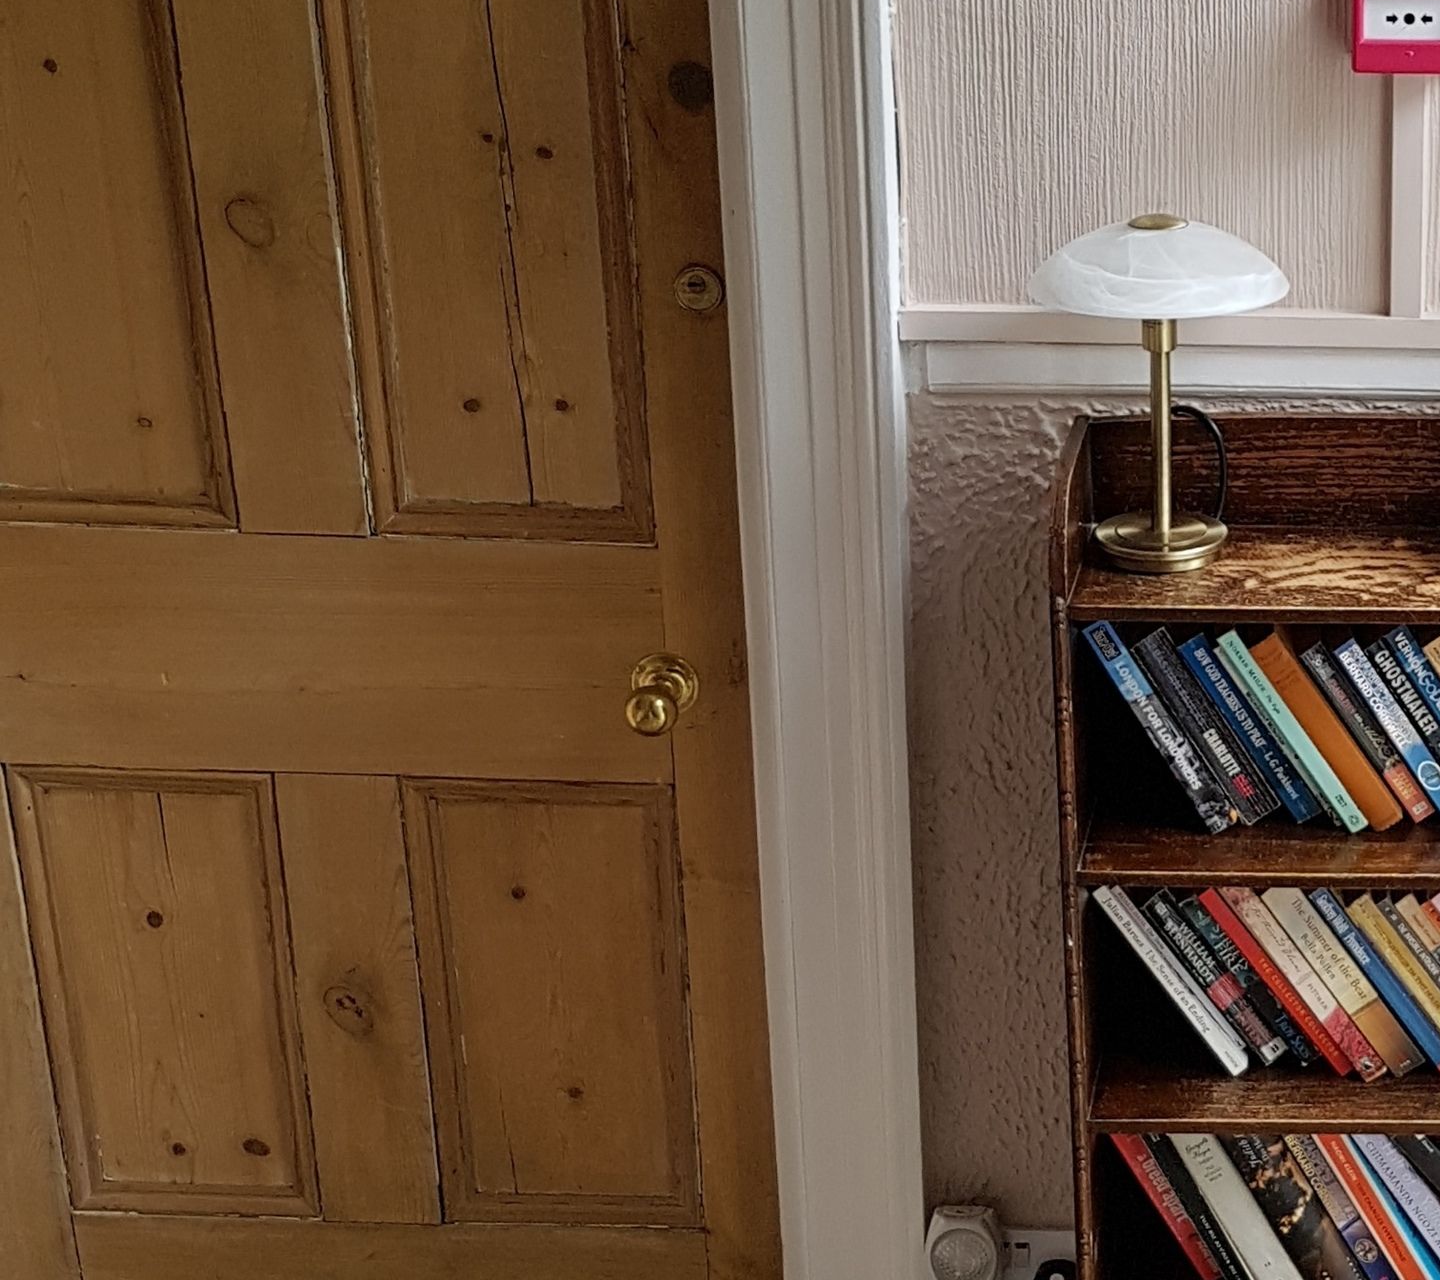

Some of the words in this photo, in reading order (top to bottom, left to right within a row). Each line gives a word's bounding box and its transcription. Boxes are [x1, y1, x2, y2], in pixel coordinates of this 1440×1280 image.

[1192, 646, 1212, 667] HOW
[1204, 662, 1222, 681] GOD
[1392, 631, 1427, 677] VERNON
[1213, 677, 1243, 713] TEACHES
[1246, 667, 1267, 692] MAILER
[1337, 650, 1375, 699] BERNARD
[1368, 695, 1409, 748] CORNWELL
[1372, 646, 1440, 736] GHOSTMAKER
[1113, 660, 1150, 707] LONDON
[1142, 704, 1164, 729] FOR
[1156, 726, 1203, 790] LONDONERS
[1234, 707, 1248, 721] US
[1240, 717, 1255, 731] TO
[1246, 726, 1267, 749] PRAY
[1202, 727, 1241, 777] CHARLOTTE
[1101, 895, 1126, 923] Julian
[1121, 920, 1146, 948] Barnes
[1143, 949, 1159, 965] The
[1155, 964, 1176, 986] Sense
[1172, 984, 1185, 997] of
[1180, 995, 1191, 1006] an
[1187, 1004, 1212, 1033] Ending
[1161, 919, 1216, 985] BERNHARDT
[1177, 921, 1216, 968] WILLIAM
[1214, 941, 1243, 974] FIRE
[1289, 896, 1307, 914] The
[1302, 914, 1335, 954] Summer
[1329, 951, 1343, 965] of
[1338, 962, 1354, 980] the
[1349, 978, 1369, 1000] Bear
[1299, 932, 1319, 954] Bella
[1315, 953, 1337, 980] Pollen
[1257, 957, 1272, 973] THE
[1269, 973, 1306, 1017] COLLECTOR
[1302, 1015, 1339, 1059] COLLECTOR
[1282, 1133, 1315, 1177] BERNARD
[1297, 1133, 1334, 1182] HARPE'S
[1140, 1157, 1170, 1193] breed
[1158, 1190, 1189, 1225] apart
[1329, 1140, 1346, 1163] NAOMI
[1342, 1162, 1357, 1182] KLEIN
[1362, 1195, 1384, 1227] CHANGES
[1363, 1140, 1415, 1206] CHIMAMANDA
[1411, 1205, 1438, 1238] NGOZI
